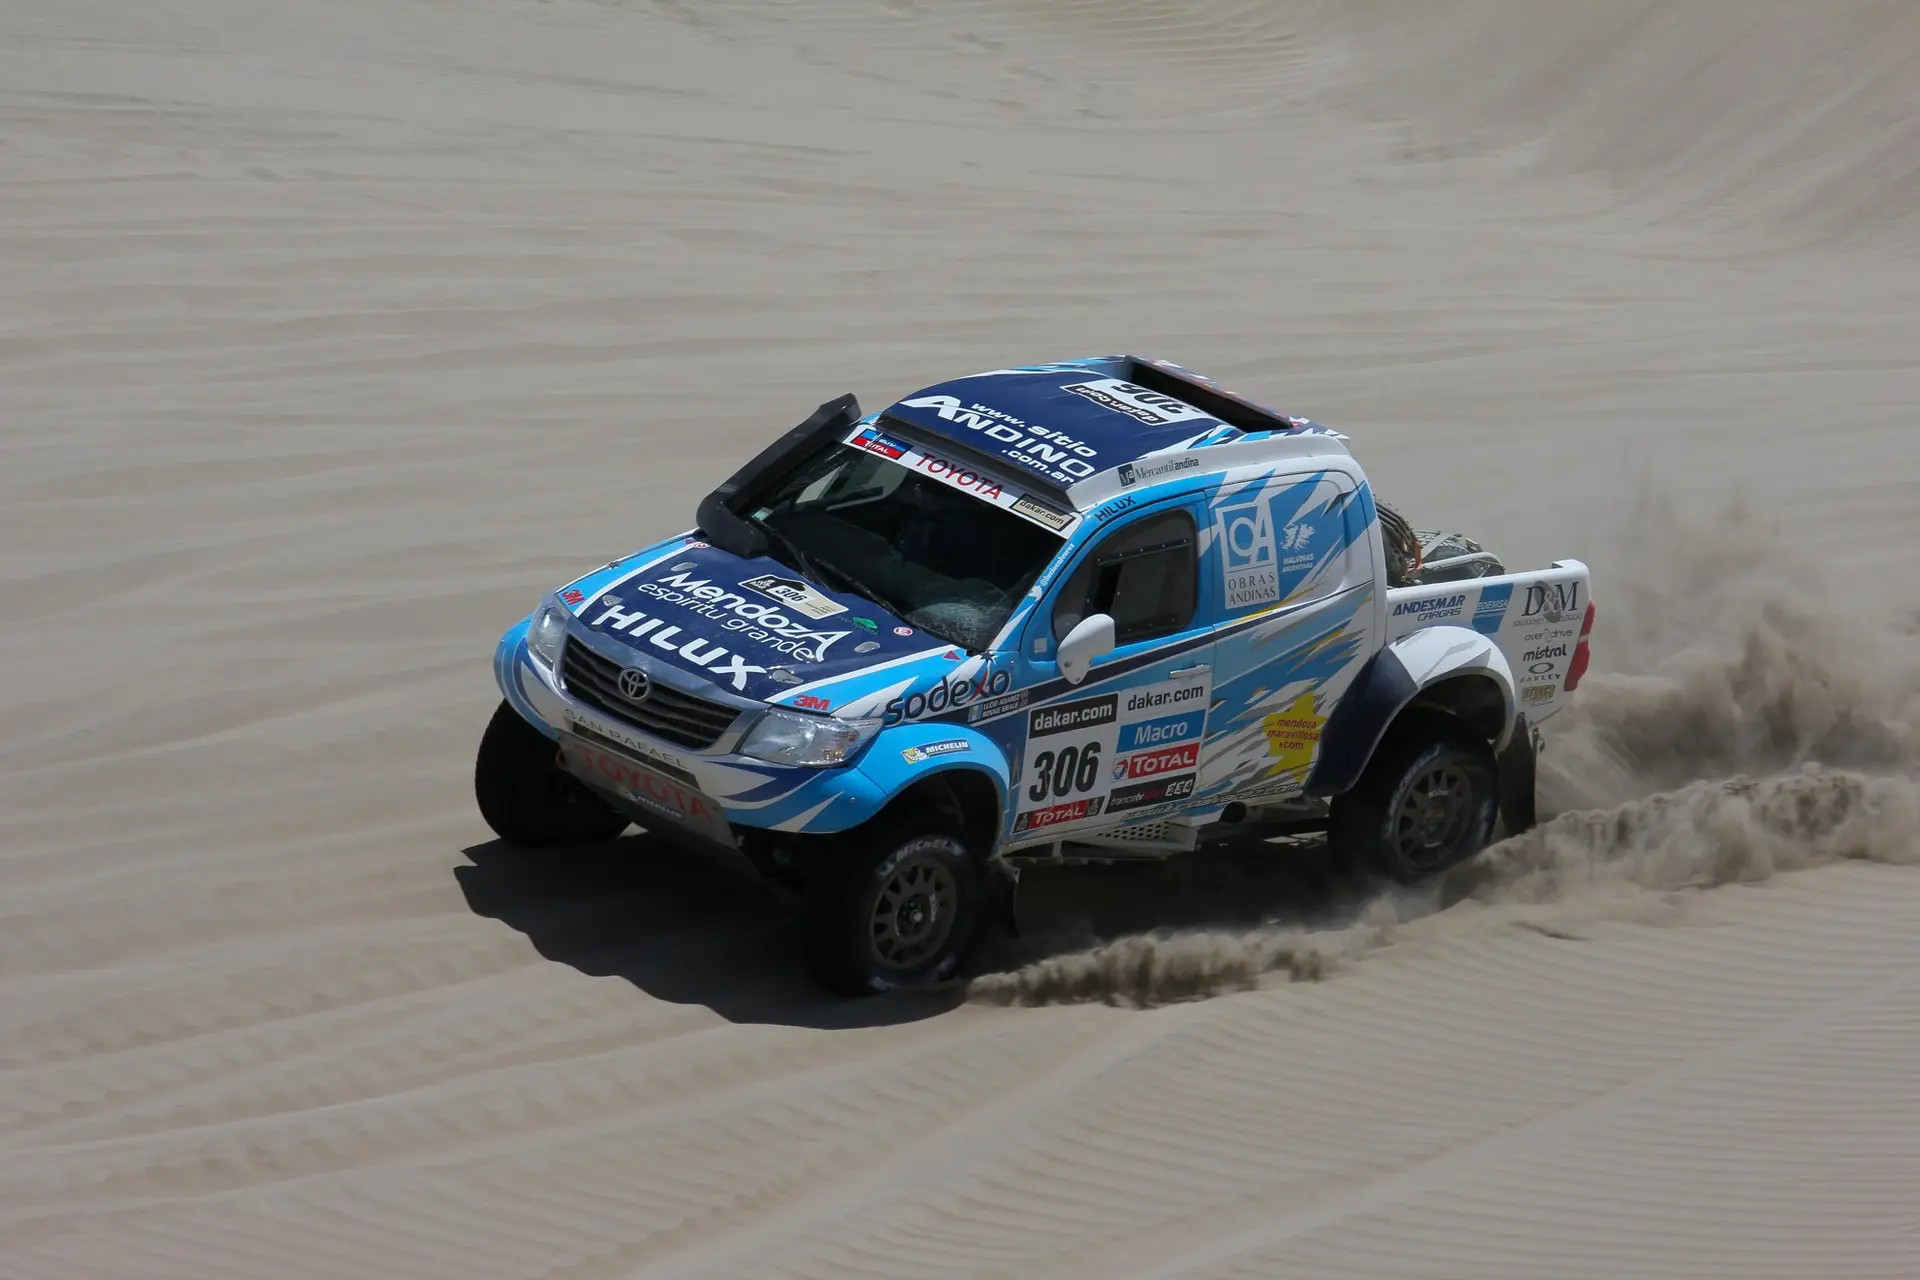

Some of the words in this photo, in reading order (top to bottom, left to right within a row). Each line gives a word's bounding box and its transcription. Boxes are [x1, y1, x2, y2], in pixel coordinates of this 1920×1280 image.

[900, 395, 1096, 481] ANDINO
[915, 452, 1005, 501] TOYOTA
[1001, 448, 1075, 485] .com.ar
[1019, 498, 1065, 526] dakar.com
[1094, 495, 1137, 523] HILUX
[1228, 571, 1276, 591] OBRAS
[562, 588, 587, 606] 3M
[774, 588, 809, 602] 306
[1228, 588, 1277, 607] ANDINAS
[1392, 594, 1466, 617] ANDESMAR
[1477, 598, 1510, 610] EDEMSA
[1521, 581, 1580, 617] D&M
[638, 580, 723, 622] espíritu
[721, 615, 816, 663] grande
[1417, 607, 1463, 622] CARGAS
[591, 600, 768, 691] HILUX
[1523, 643, 1567, 662] mistral
[1519, 673, 1562, 684] OAKLEY
[793, 693, 831, 711] 3M
[886, 663, 1012, 722] sodexo
[1127, 686, 1204, 711] dakar.com
[1034, 702, 1113, 731] dakar.com
[1277, 718, 1317, 729] mendoza
[565, 708, 603, 734] SAN
[609, 729, 689, 770] RAFAEL
[1134, 720, 1188, 745] Macro
[1267, 729, 1321, 741] maravillosa
[925, 739, 969, 754] MICHELIN
[1028, 741, 1102, 802] 306
[1134, 750, 1195, 773] TOTAL
[573, 743, 716, 825] TOYOTA
[1033, 805, 1084, 824] TOTAL
